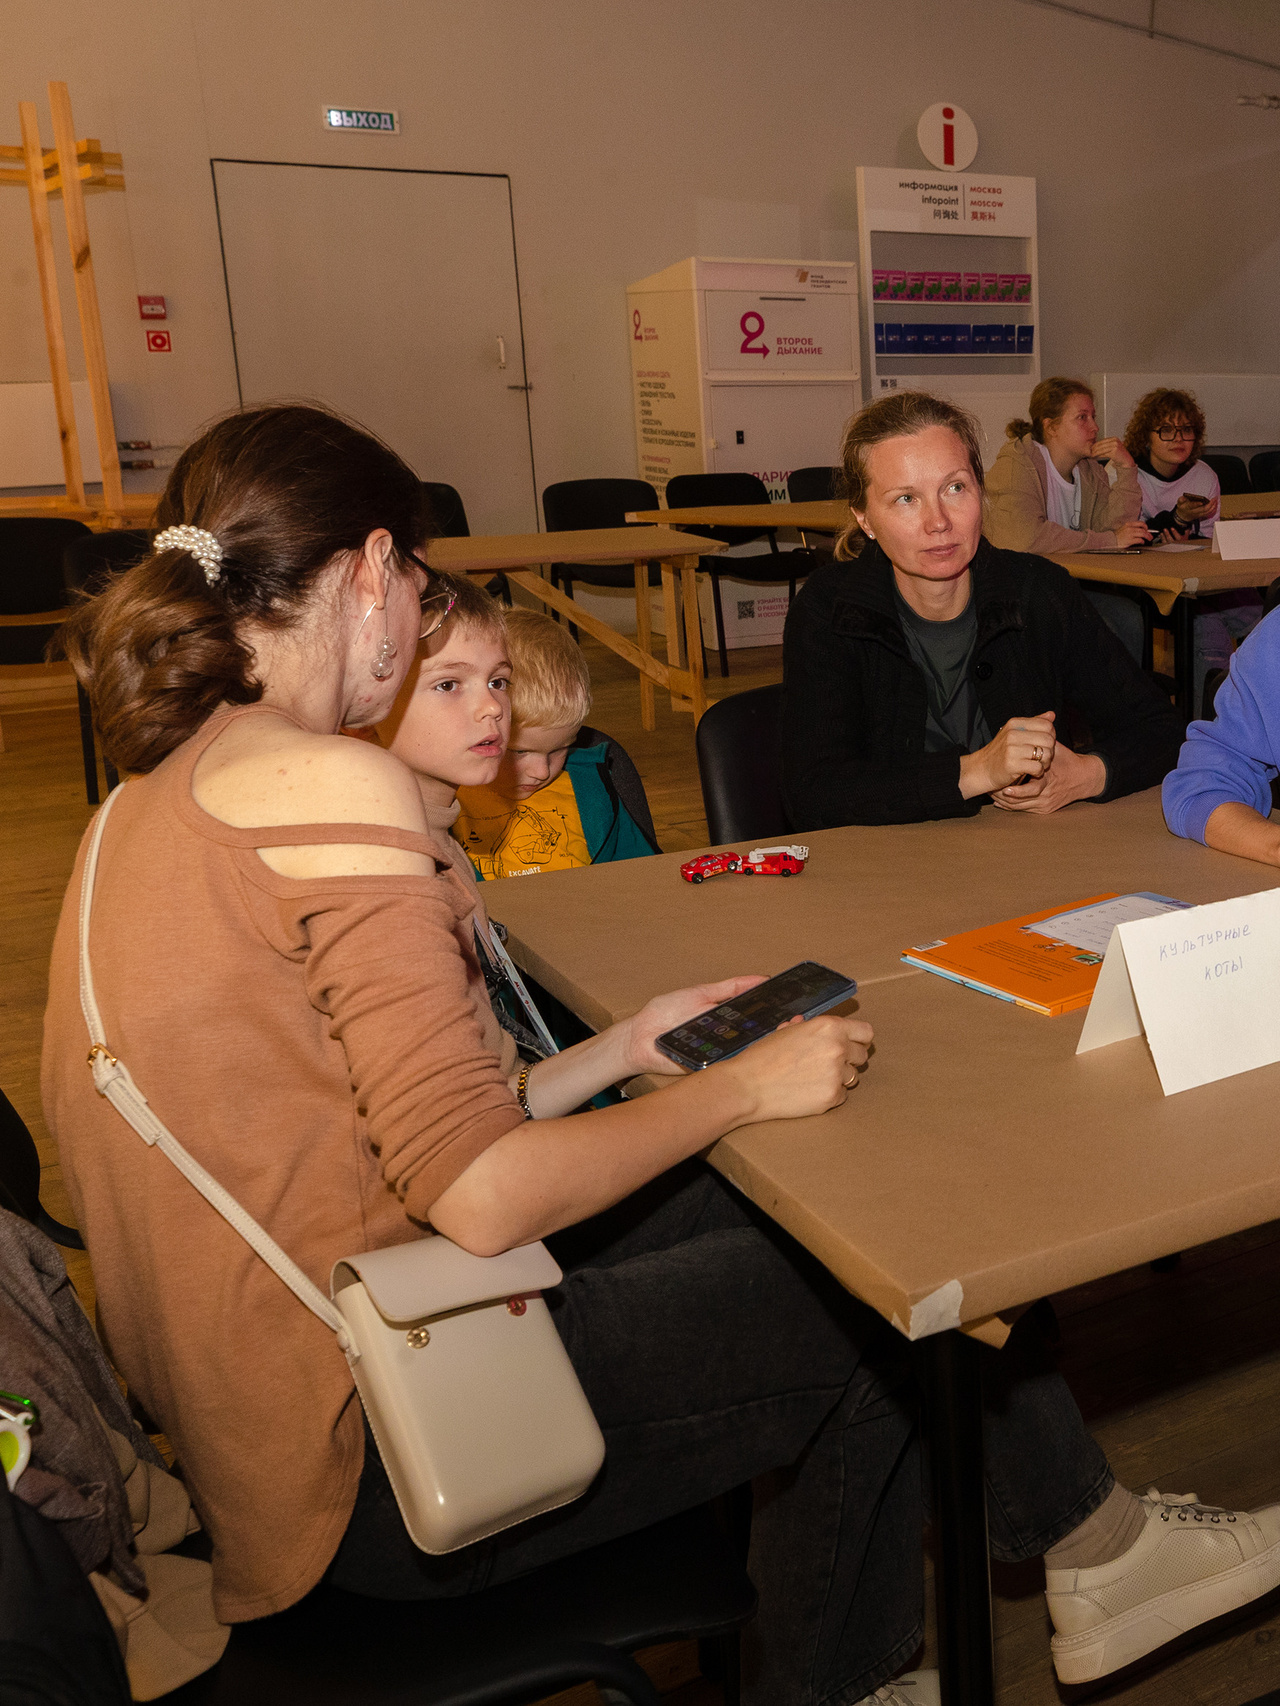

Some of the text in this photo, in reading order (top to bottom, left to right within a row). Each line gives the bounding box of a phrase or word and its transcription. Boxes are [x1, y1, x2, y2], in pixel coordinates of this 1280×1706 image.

[330, 110, 393, 130] ВЫХОД
[899, 181, 958, 192] информация
[921, 195, 959, 206] infopoint
[776, 337, 813, 346] ВТОРОЕ
[776, 347, 823, 356] ДЫХАНИЕ
[1204, 956, 1243, 981] КОТЫ
